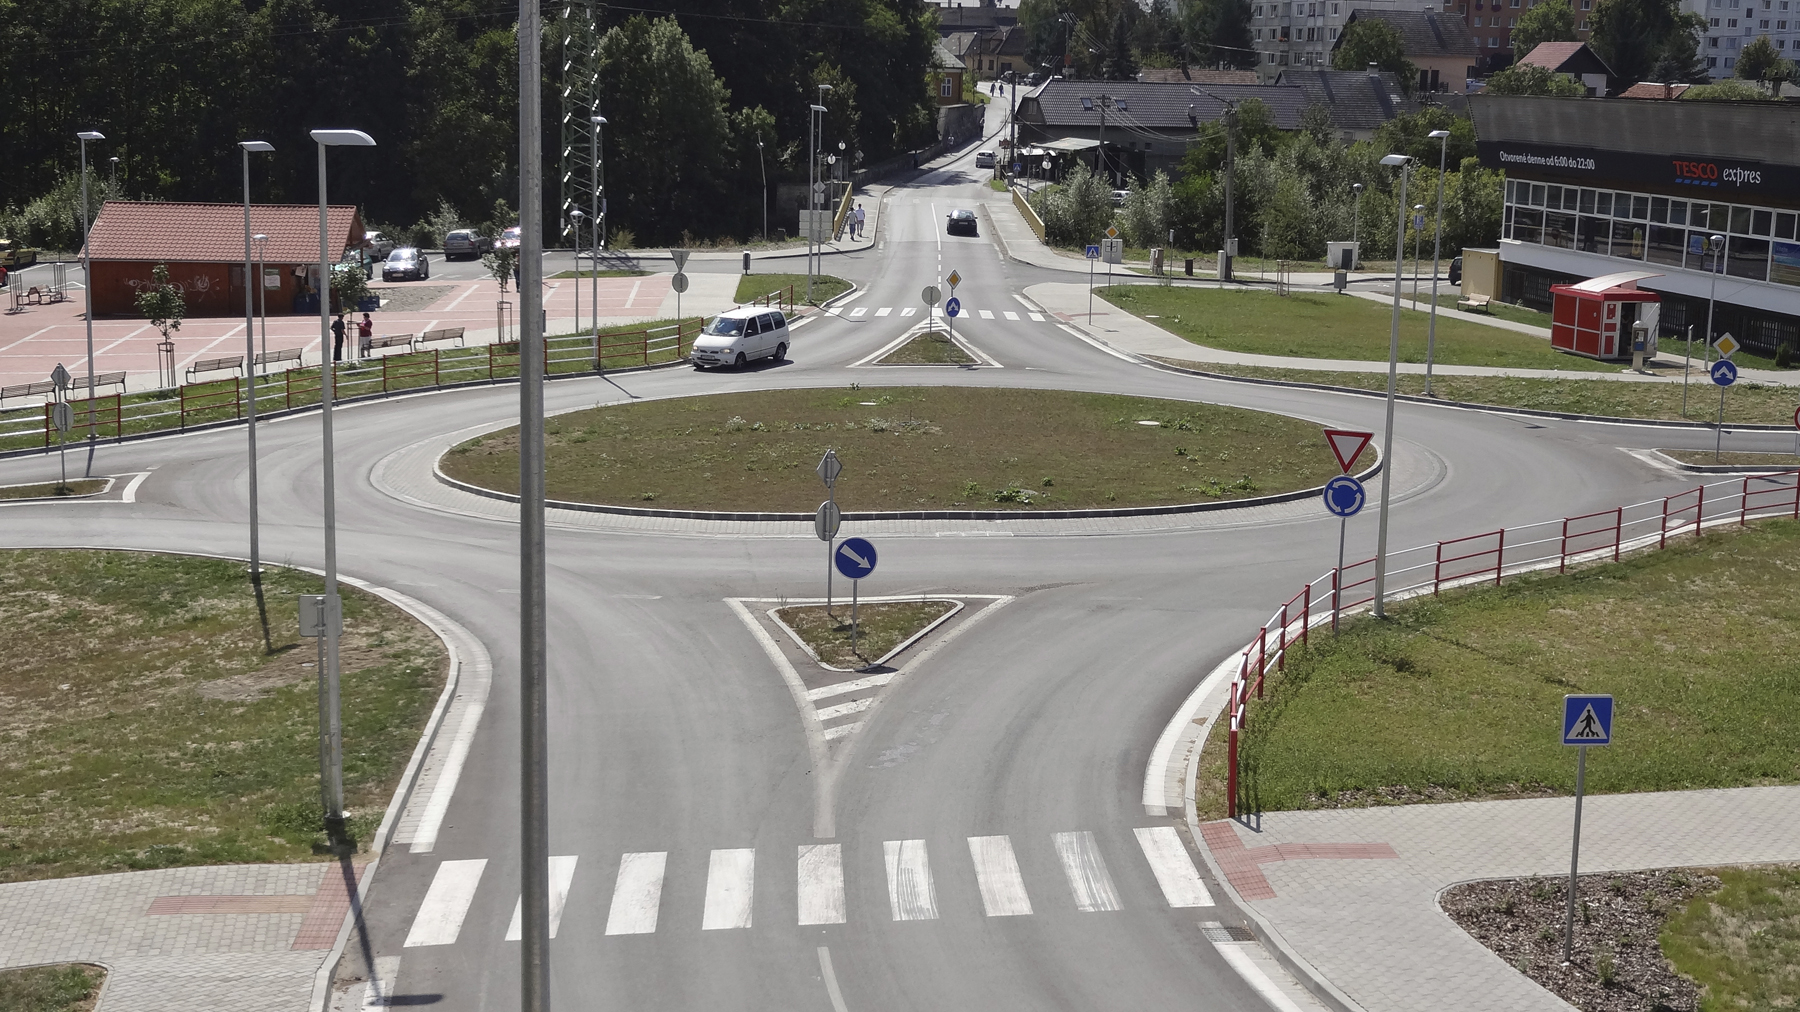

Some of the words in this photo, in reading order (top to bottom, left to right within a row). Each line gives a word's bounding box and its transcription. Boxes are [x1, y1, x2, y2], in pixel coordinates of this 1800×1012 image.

[1499, 150, 1526, 163] Otvorené
[1527, 153, 1545, 165] denne
[1546, 155, 1554, 166] od
[1555, 155, 1568, 167] 6:00
[1568, 157, 1577, 168] do
[1577, 158, 1595, 170] 22:00
[1672, 161, 1718, 179] TESCO
[1722, 167, 1761, 187] expres
